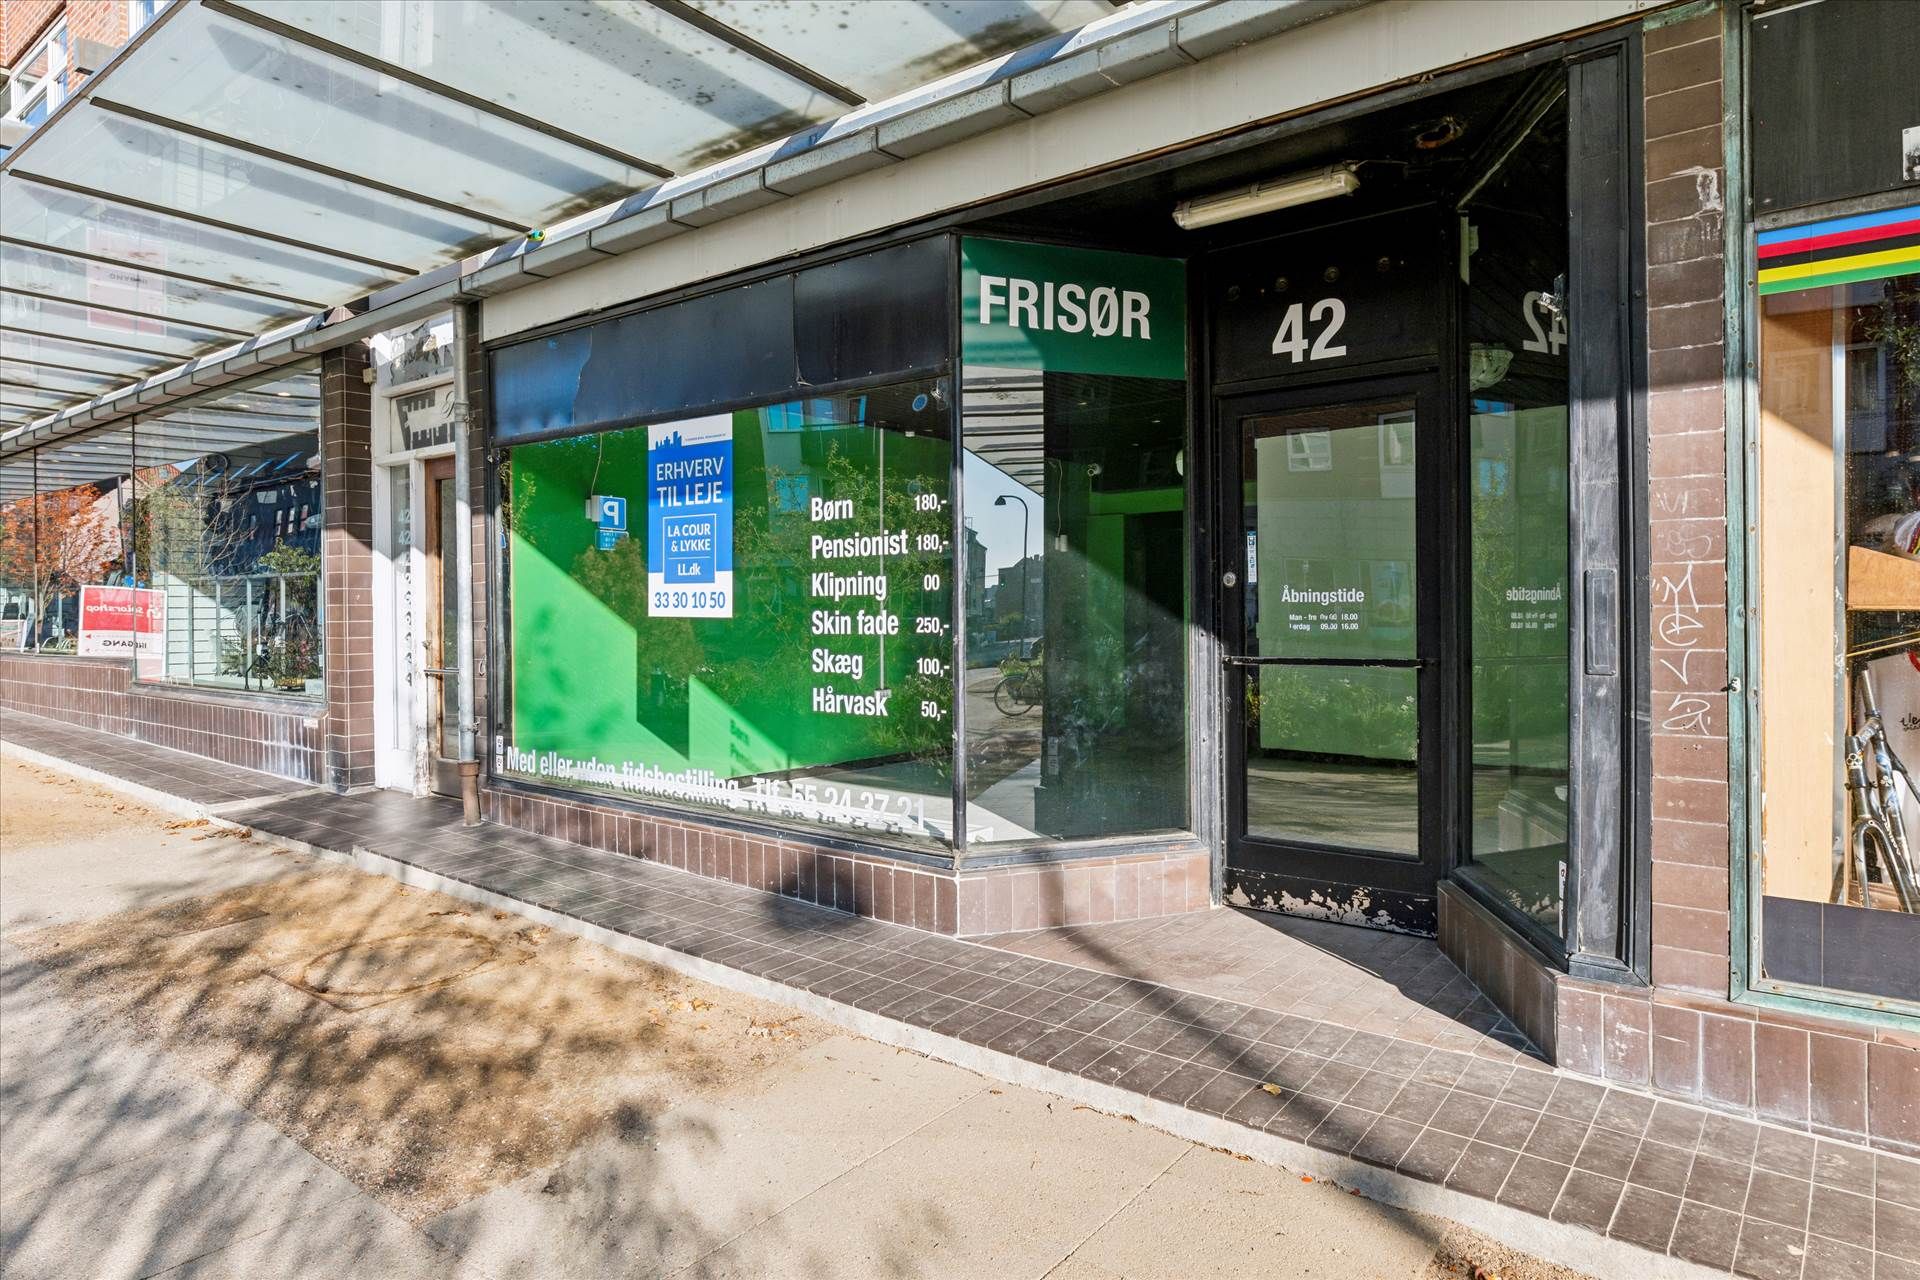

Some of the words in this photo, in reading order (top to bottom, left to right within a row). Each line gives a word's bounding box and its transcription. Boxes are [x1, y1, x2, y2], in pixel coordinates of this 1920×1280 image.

[980, 275, 1151, 340] FRISØR
[1272, 298, 1347, 363] 42
[656, 456, 724, 481] ERHVERV
[656, 485, 682, 508] TIL
[685, 481, 723, 506] LEJE
[811, 497, 853, 522] Børn
[914, 493, 947, 512] 180,-
[667, 525, 680, 537] LA
[682, 523, 711, 536] COUR
[811, 529, 908, 559] Pensionist
[915, 534, 949, 553] 180,-
[671, 541, 678, 552] &
[680, 539, 711, 552] LYKKE
[677, 562, 701, 576] LL.dk
[654, 592, 669, 608] 33
[672, 592, 688, 608] 30
[691, 592, 707, 608] 10
[710, 592, 726, 608] 50
[811, 571, 887, 602] Klipning
[923, 574, 940, 591] 00
[1281, 585, 1365, 606] Åbningstide
[811, 610, 852, 635] Skin
[856, 610, 899, 635] fade
[916, 617, 950, 637] 250,-
[812, 648, 863, 680] Skæg
[916, 657, 950, 677] 100,-
[812, 685, 888, 716] Hårvask
[921, 701, 947, 722] 50,-
[506, 746, 536, 774] Med
[540, 751, 573, 776] eller
